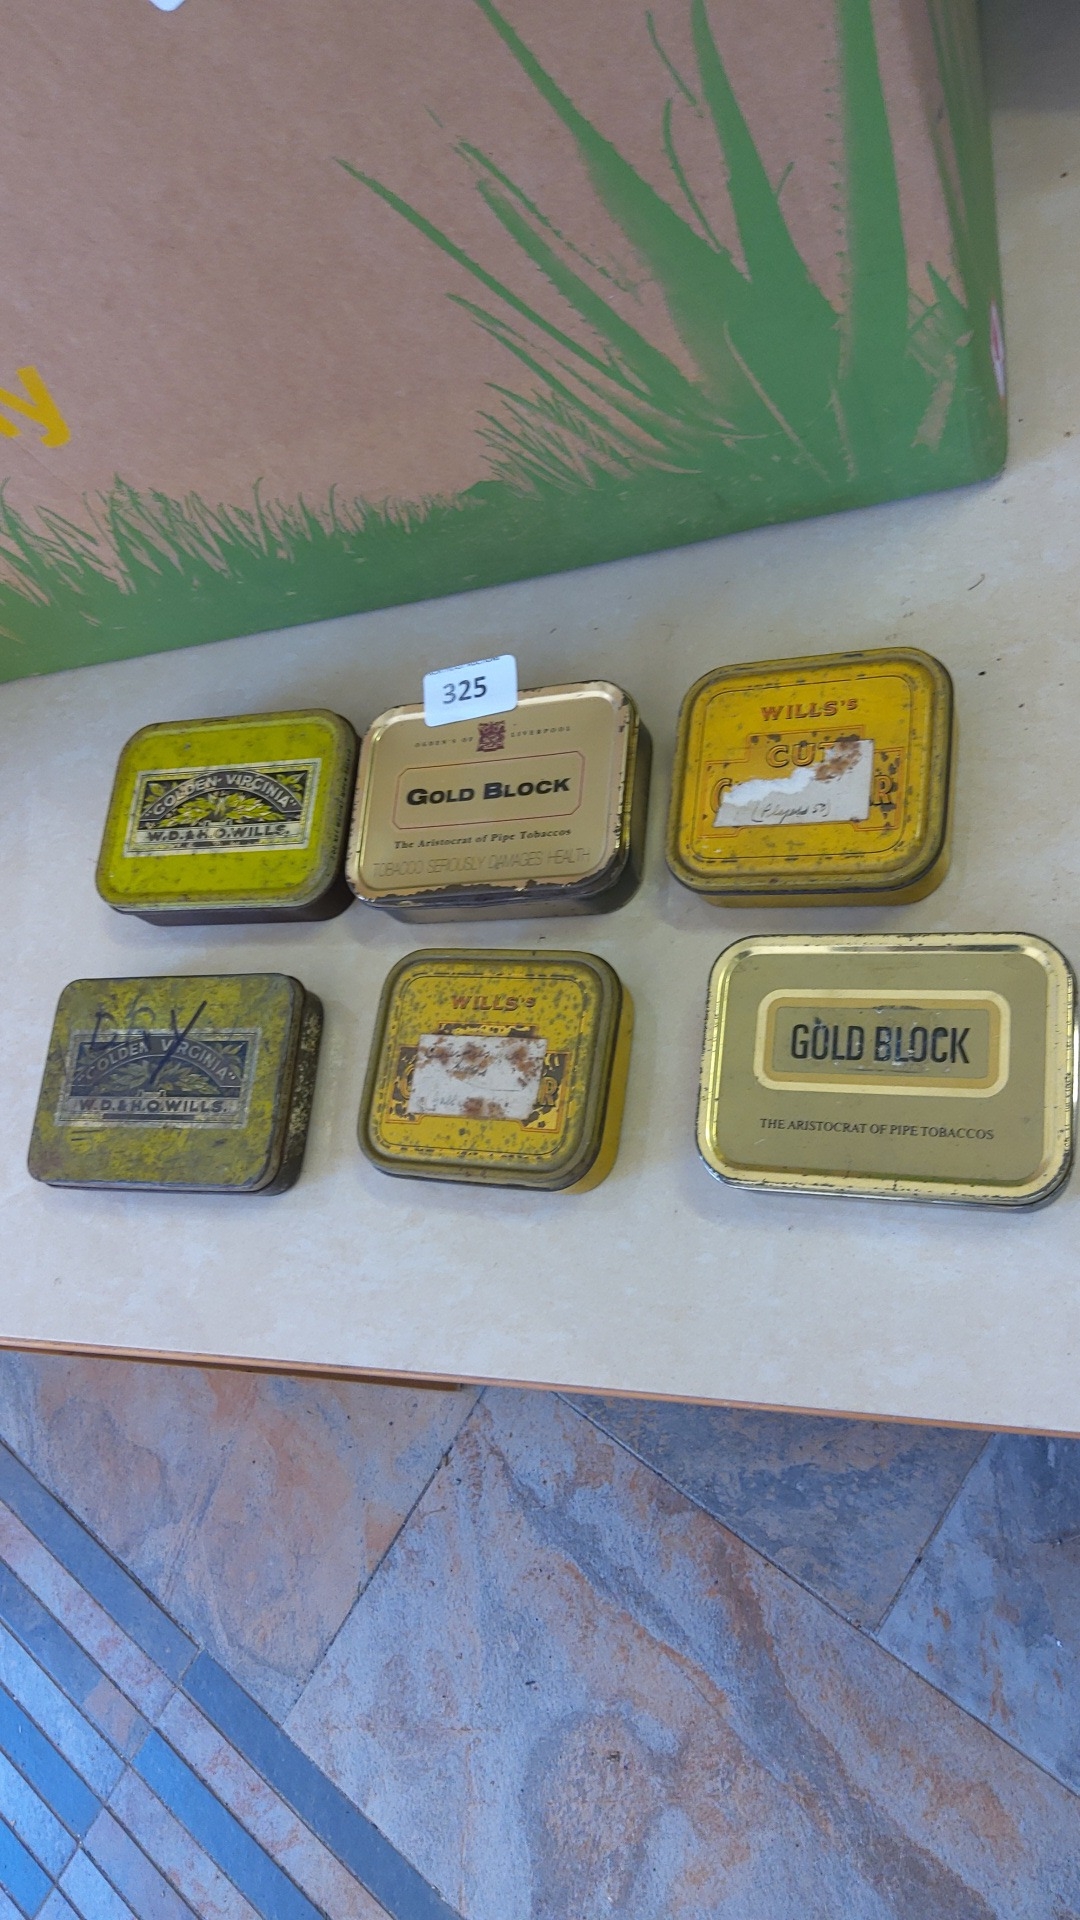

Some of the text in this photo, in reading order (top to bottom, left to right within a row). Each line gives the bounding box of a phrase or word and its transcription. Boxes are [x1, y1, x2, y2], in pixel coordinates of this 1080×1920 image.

[0, 364, 71, 448] y
[442, 675, 487, 705] 325
[394, 828, 571, 850] The Aristocrat of Pipe Tobaccos
[373, 847, 590, 878] TOBACCO SERIOUSLY DAMAGES HEALTH
[791, 1024, 971, 1065] GOLD BLOCK
[760, 1118, 994, 1140] THE ARISTOCRAT OF PIPE TOBACCOS
